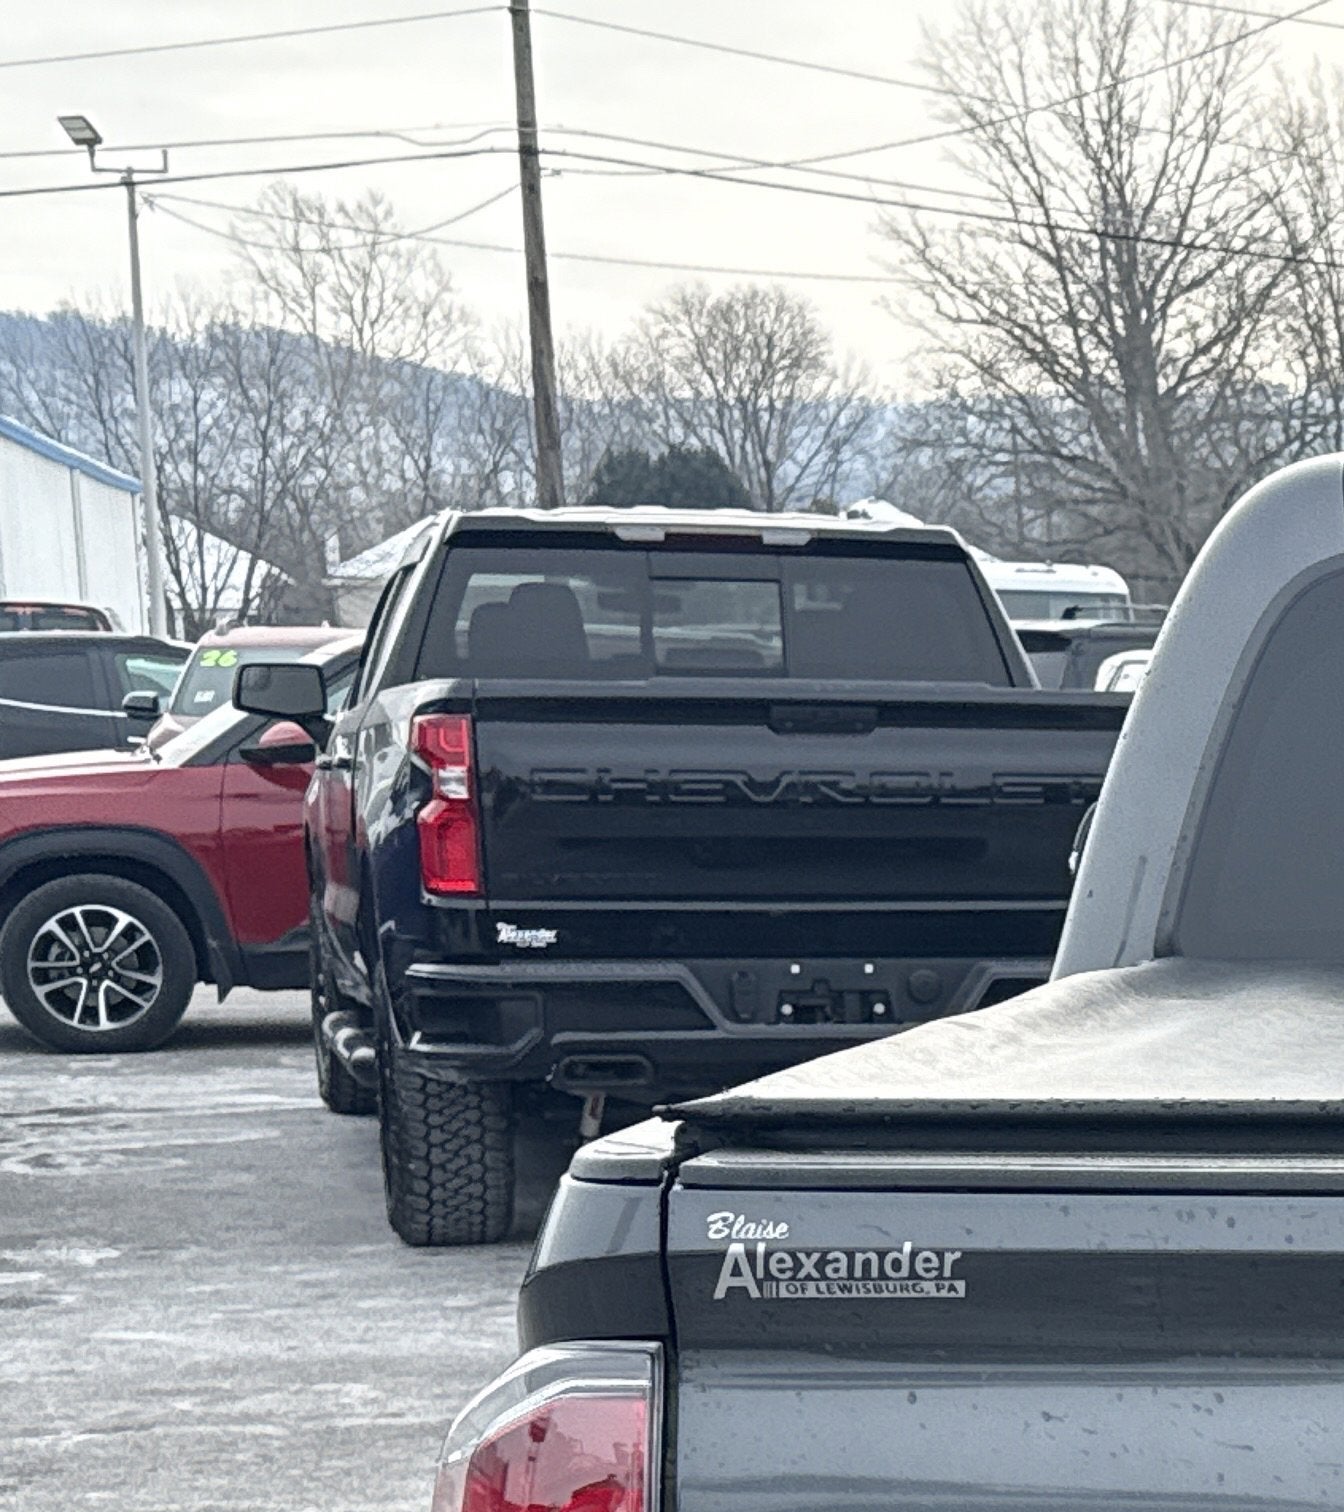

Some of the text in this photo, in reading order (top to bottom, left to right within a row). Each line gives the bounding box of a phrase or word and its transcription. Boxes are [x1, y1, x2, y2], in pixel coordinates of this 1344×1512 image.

[200, 649, 237, 667] 26
[706, 1211, 790, 1239] Blaise
[713, 1241, 962, 1300] Alexander
[785, 1282, 808, 1295] OF
[935, 1282, 960, 1295] PA
